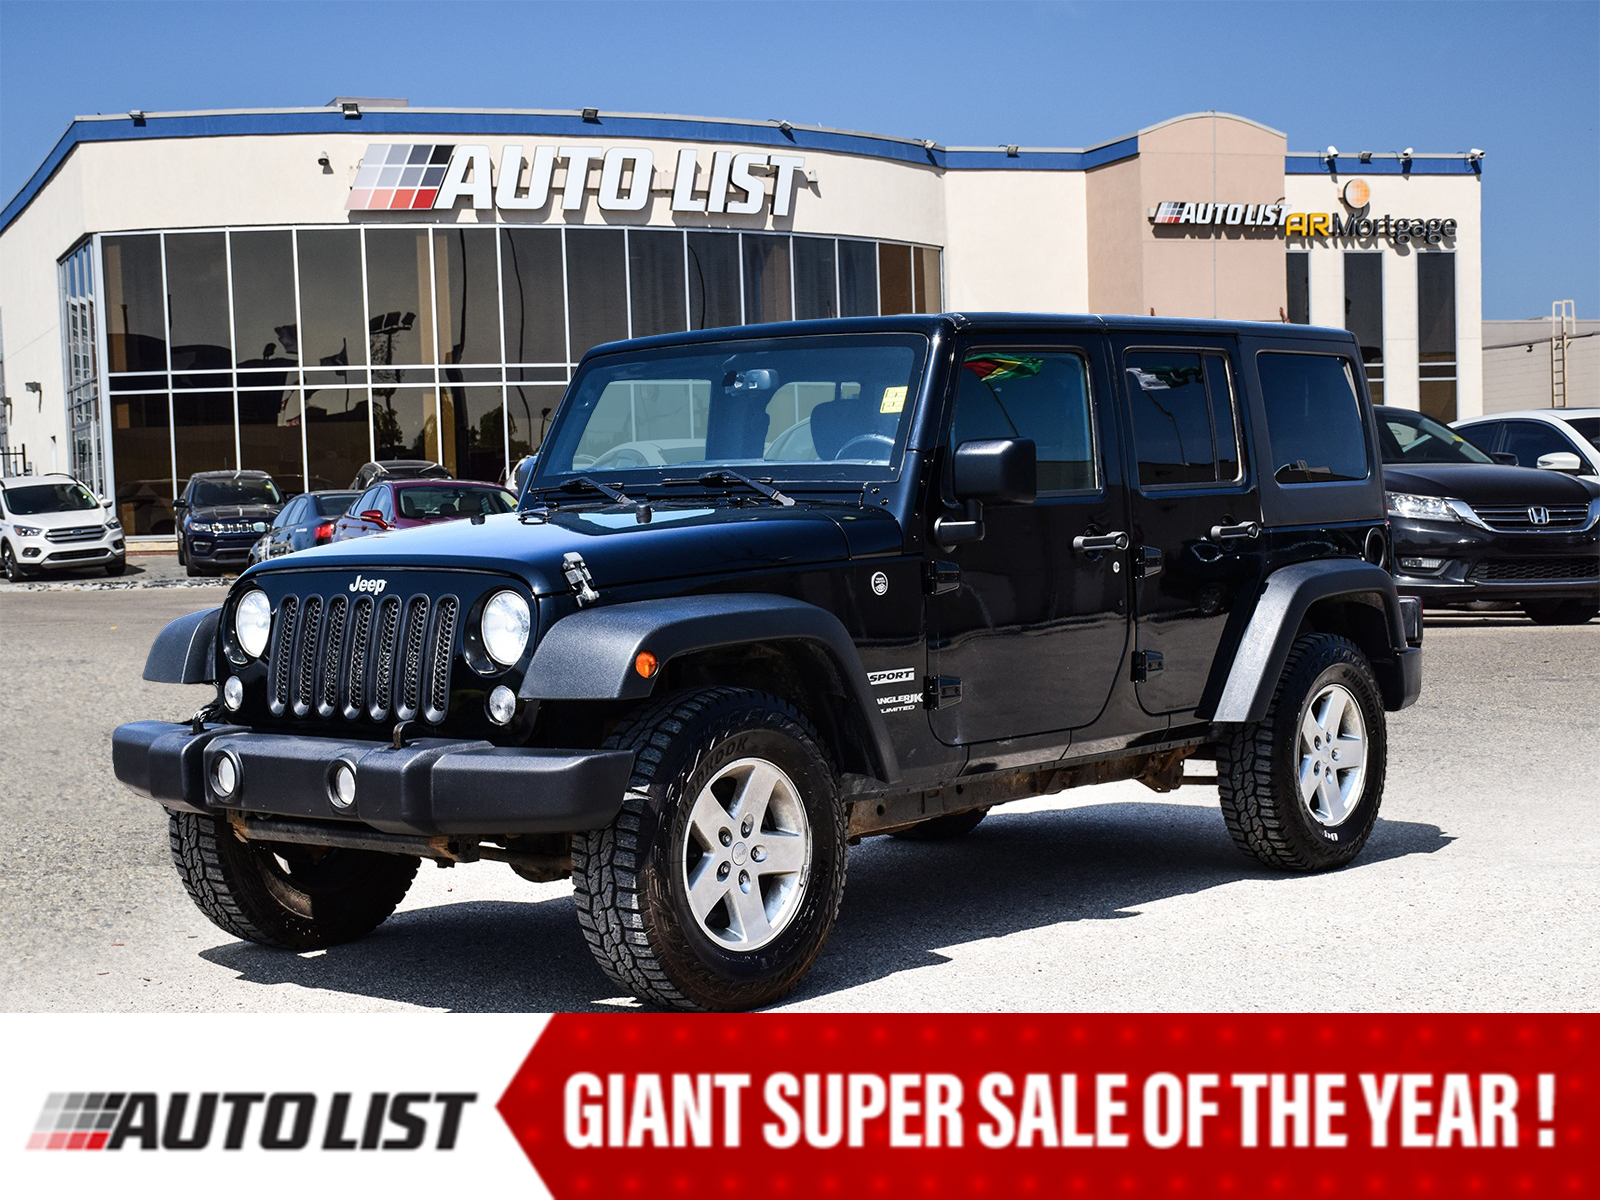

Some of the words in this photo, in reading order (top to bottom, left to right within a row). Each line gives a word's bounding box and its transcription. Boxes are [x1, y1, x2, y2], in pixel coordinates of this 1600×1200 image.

[434, 144, 654, 211] AUTO
[672, 149, 805, 216] LIST
[1286, 213, 1329, 236] AR
[1333, 212, 1457, 244] Mortgage
[349, 575, 387, 595] Jeep
[869, 671, 914, 682] SPORT
